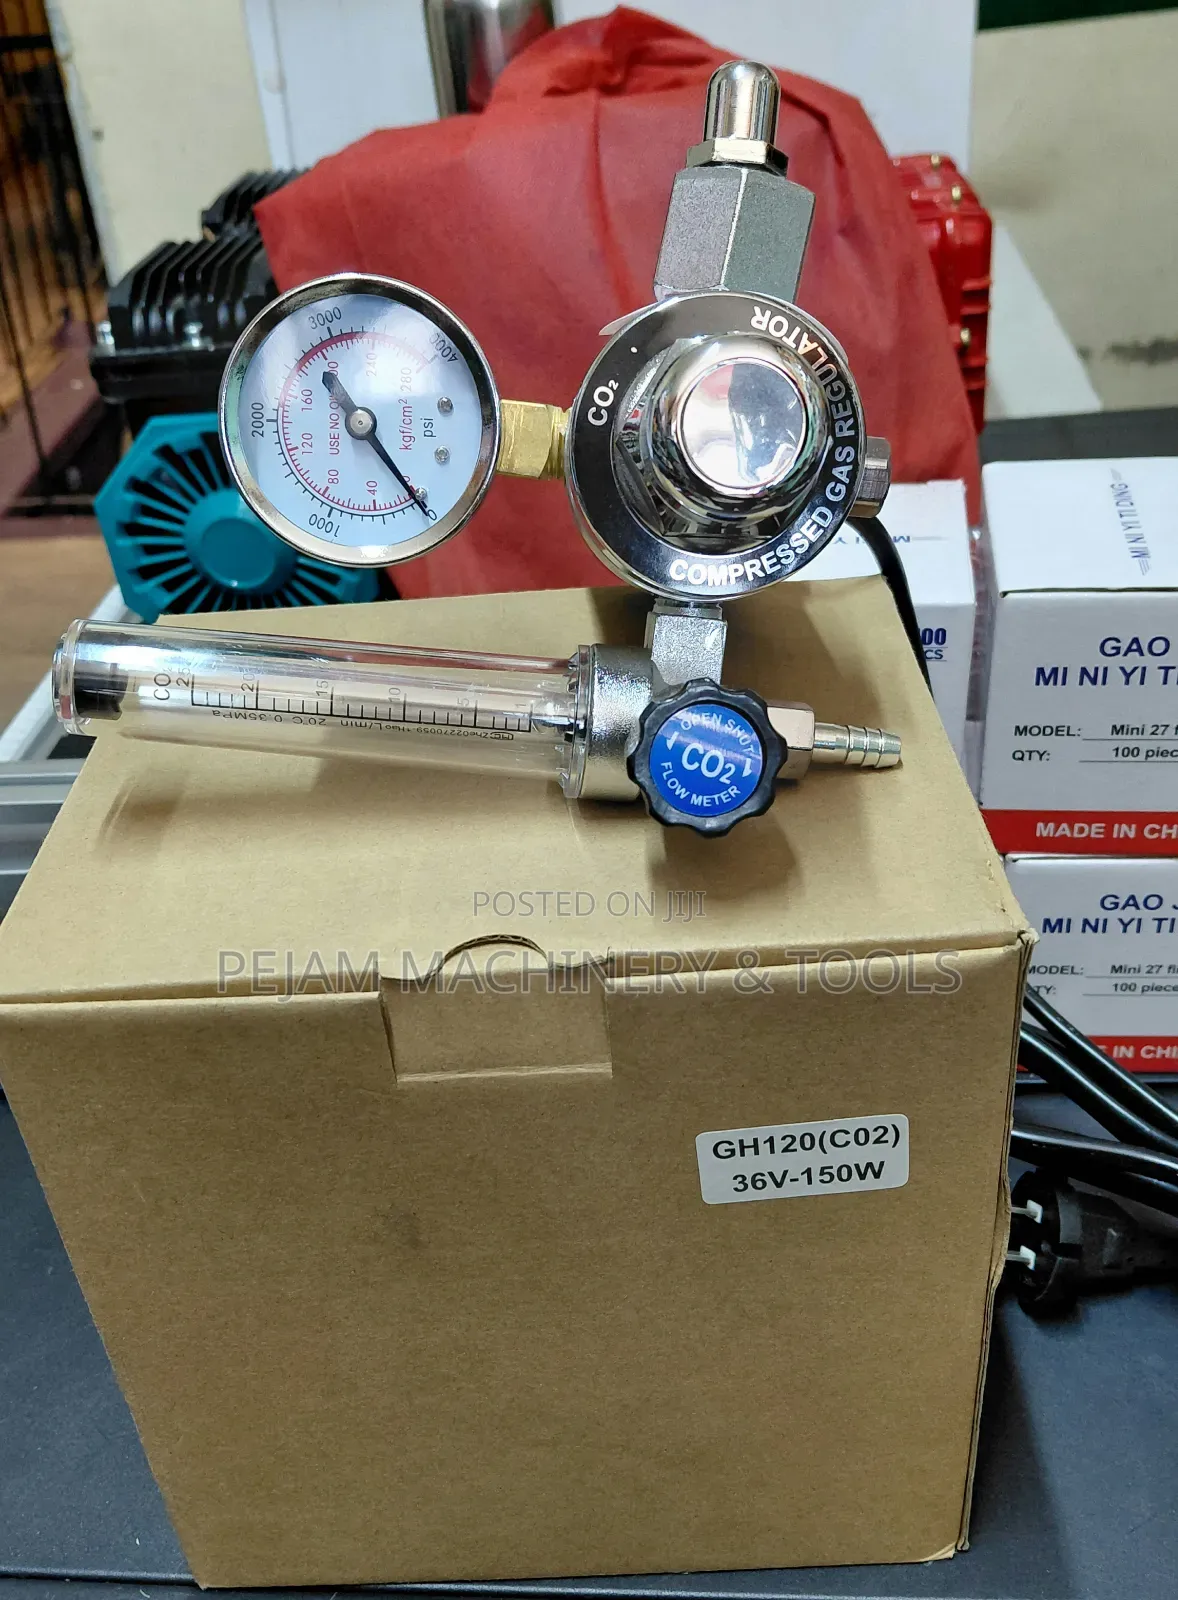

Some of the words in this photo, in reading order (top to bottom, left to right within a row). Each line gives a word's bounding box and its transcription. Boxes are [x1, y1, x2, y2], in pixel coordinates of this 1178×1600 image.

[309, 307, 342, 330] 3000
[366, 352, 378, 377] 240
[750, 305, 856, 437] REGULATOR
[400, 367, 413, 393] 280
[301, 388, 313, 413] 160
[251, 402, 265, 438] 2000
[329, 412, 340, 430] NO
[420, 417, 437, 438] psi
[301, 432, 313, 456] 120
[329, 432, 340, 456] USE
[327, 468, 340, 485] 80
[825, 442, 855, 502] GAS
[365, 480, 378, 496] 40
[308, 513, 342, 538] 1000
[669, 507, 833, 587] COMPRESSED
[1099, 636, 1171, 658] GAO
[1034, 666, 1068, 686] MI
[1078, 666, 1109, 686] NI
[1119, 666, 1147, 686] YI
[316, 680, 329, 697] 15
[388, 687, 401, 703] 10
[340, 718, 382, 731] L/min
[680, 712, 723, 731] OPEN
[724, 718, 755, 753] SHUT
[1013, 725, 1082, 737] MODEL:
[1110, 723, 1146, 736] Mini
[1149, 724, 1170, 736] 27
[1012, 749, 1051, 762] QTY:
[1111, 746, 1140, 758] 100
[661, 761, 690, 800] FLOW
[690, 785, 741, 807] METER
[1036, 822, 1105, 839] MADE
[1112, 822, 1137, 839] IN
[1099, 893, 1164, 911] GAO
[1042, 917, 1072, 934] MI
[1081, 917, 1109, 934] NI
[1118, 917, 1142, 934] YI
[1110, 963, 1141, 974] Mini
[1144, 964, 1164, 975] 27
[1112, 982, 1137, 992] 100
[1112, 1044, 1135, 1059] IN
[732, 1160, 886, 1193] 36V-150W
